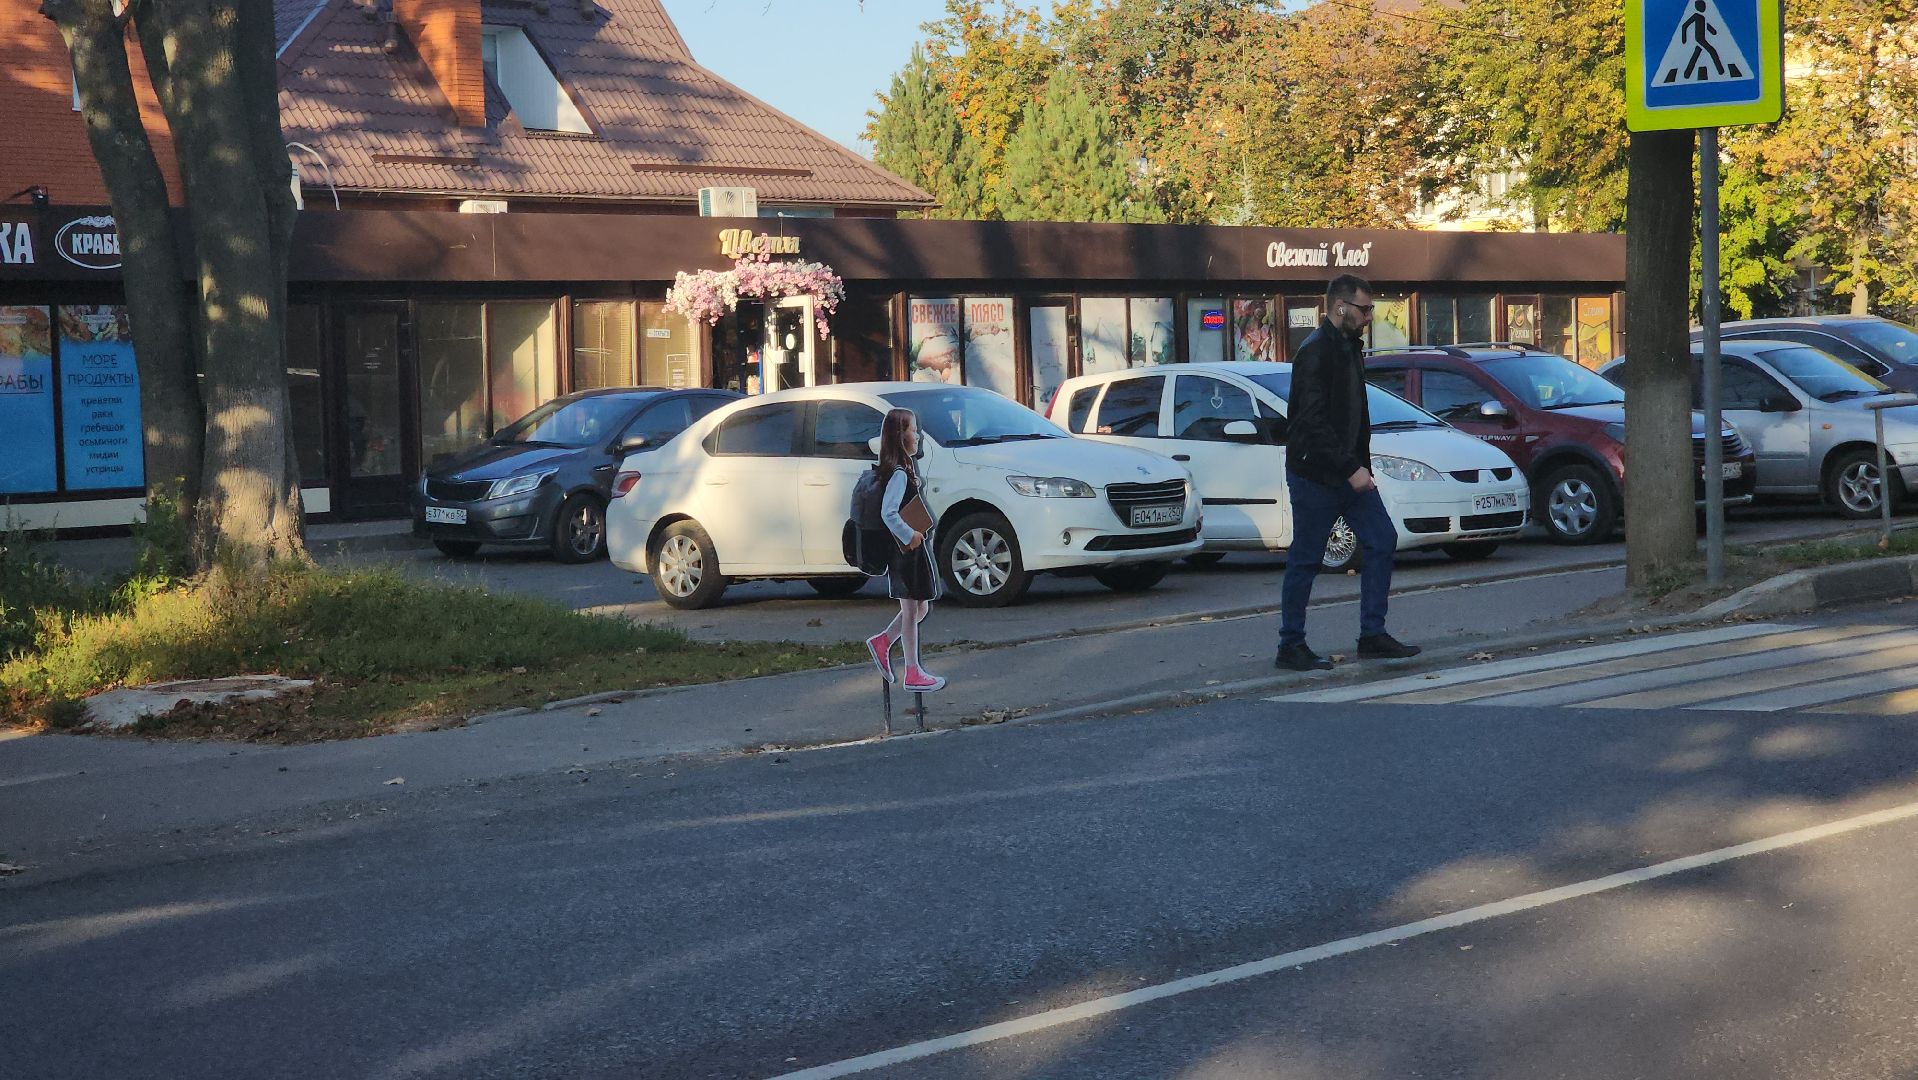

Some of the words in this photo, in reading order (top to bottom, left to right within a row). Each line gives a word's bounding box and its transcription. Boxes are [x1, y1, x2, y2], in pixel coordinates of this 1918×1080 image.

[1266, 241, 1329, 268] Свежий
[1331, 241, 1373, 268] Хлеб
[911, 303, 957, 324] СВЕЖЕЕ
[971, 303, 1005, 323] МЯСО
[82, 354, 118, 365] МОРЕ
[0, 374, 43, 390] АБЫ
[68, 373, 134, 385] ПРОДУКТЫ
[81, 423, 124, 434] гребешок
[79, 438, 128, 447] осьминоги
[85, 465, 124, 476] устрицы
